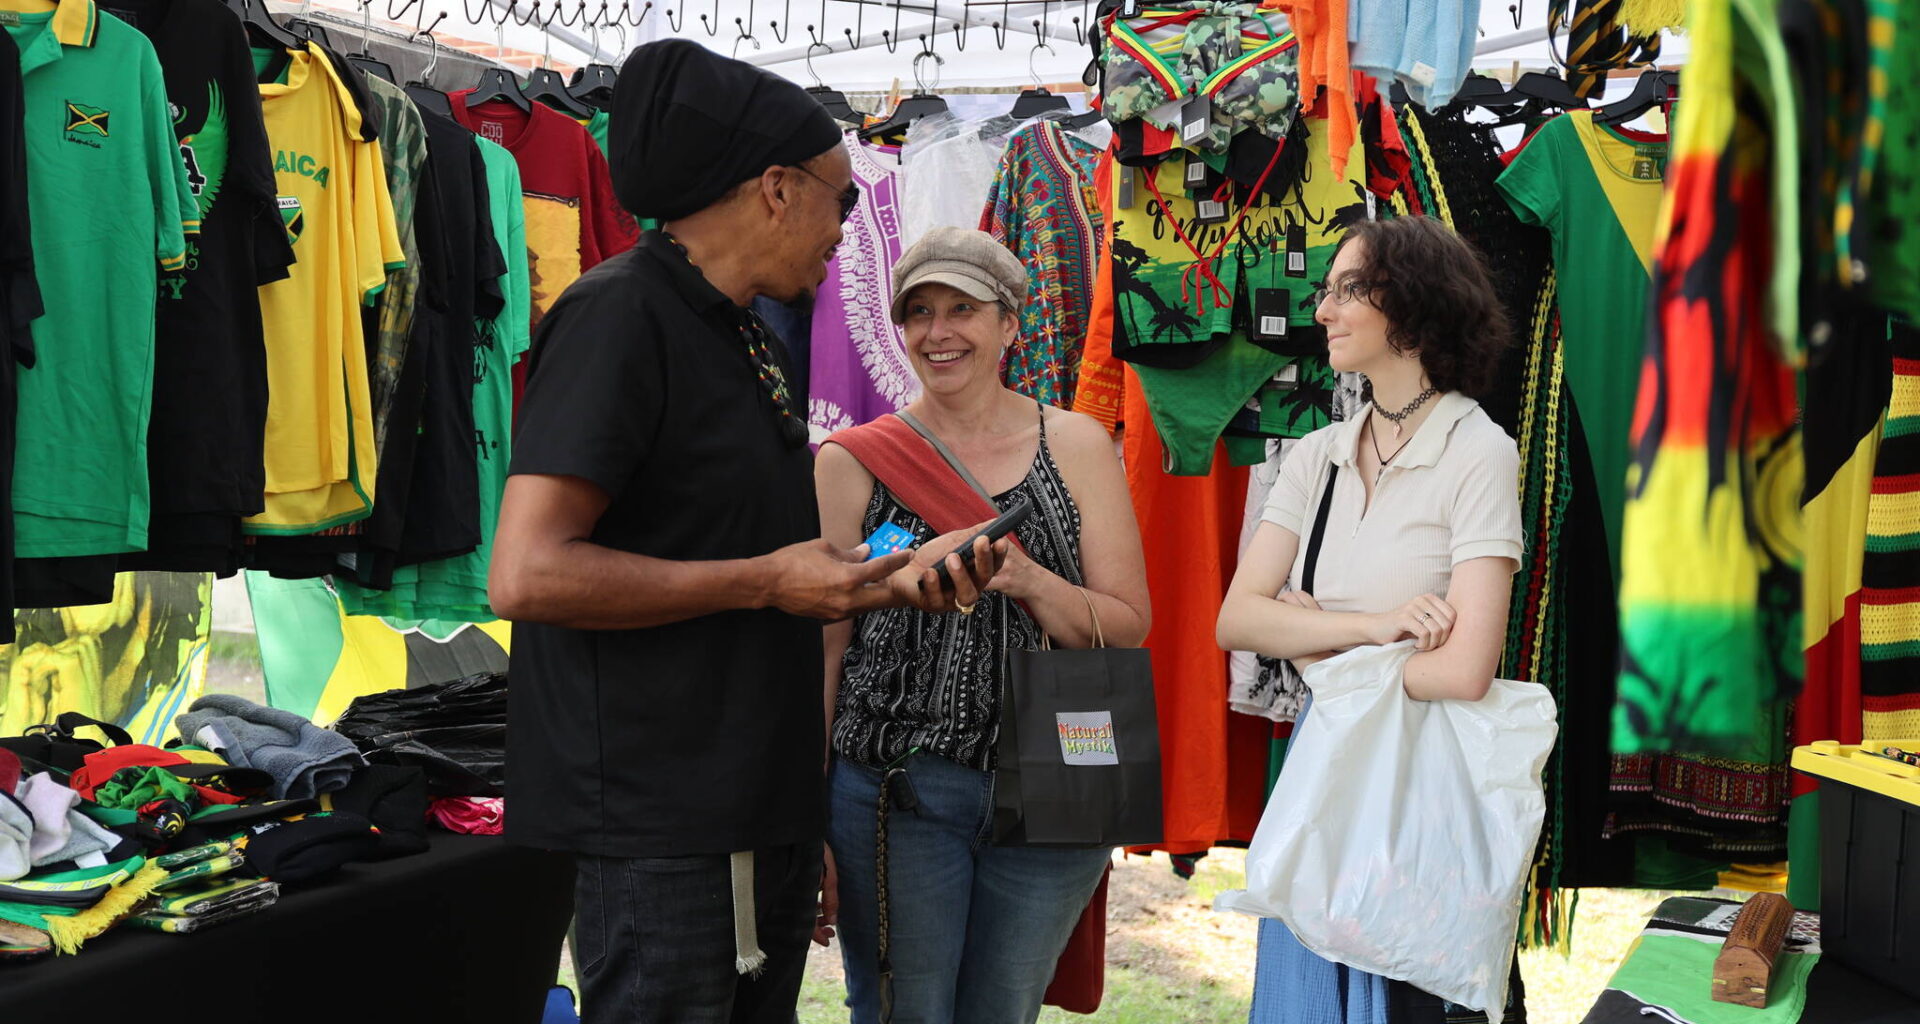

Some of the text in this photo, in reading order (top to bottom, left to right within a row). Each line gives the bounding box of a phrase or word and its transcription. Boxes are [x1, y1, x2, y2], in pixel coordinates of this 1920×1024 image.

[274, 149, 330, 190] AICA
[277, 199, 298, 207] AICA
[1058, 722, 1113, 739] Natural
[1064, 739, 1114, 755] Mystik
